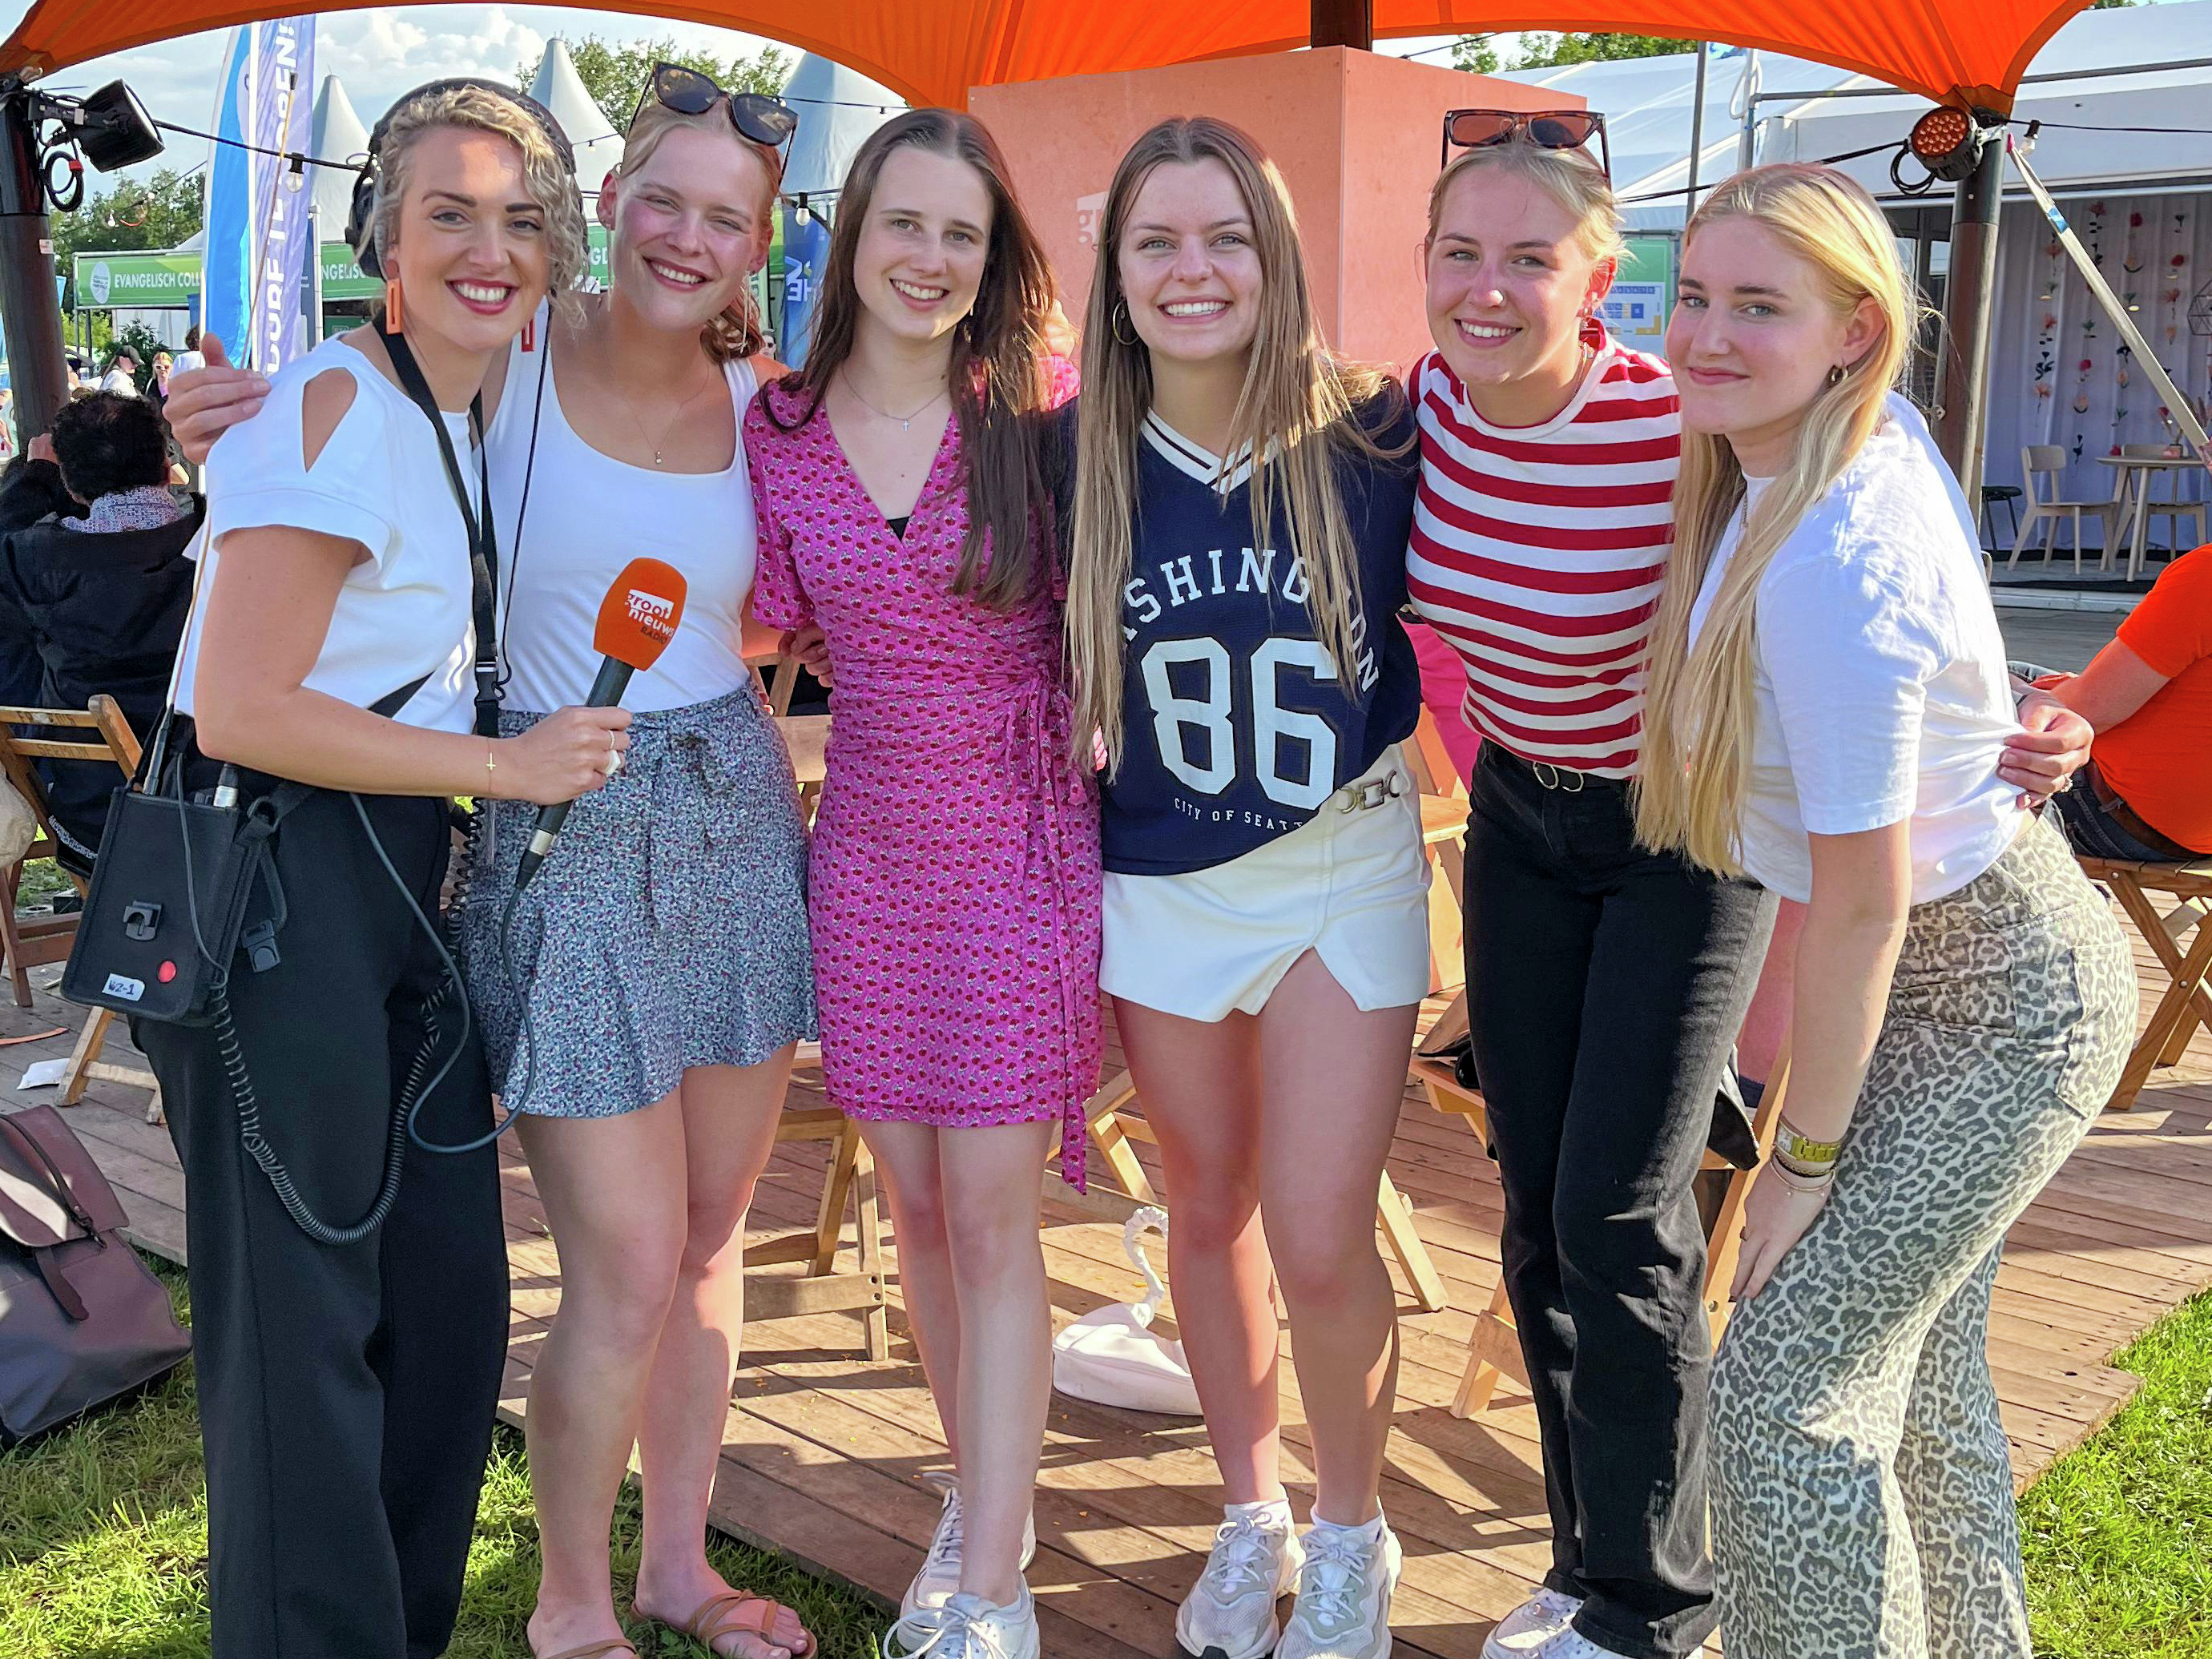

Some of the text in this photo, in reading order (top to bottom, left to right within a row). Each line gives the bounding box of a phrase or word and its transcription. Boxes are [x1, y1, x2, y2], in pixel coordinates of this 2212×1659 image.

[115, 273, 175, 288] EVANGELISCH
[1141, 636, 1339, 811] 86
[1174, 798, 1201, 820] CITY
[1212, 810, 1235, 822] OF
